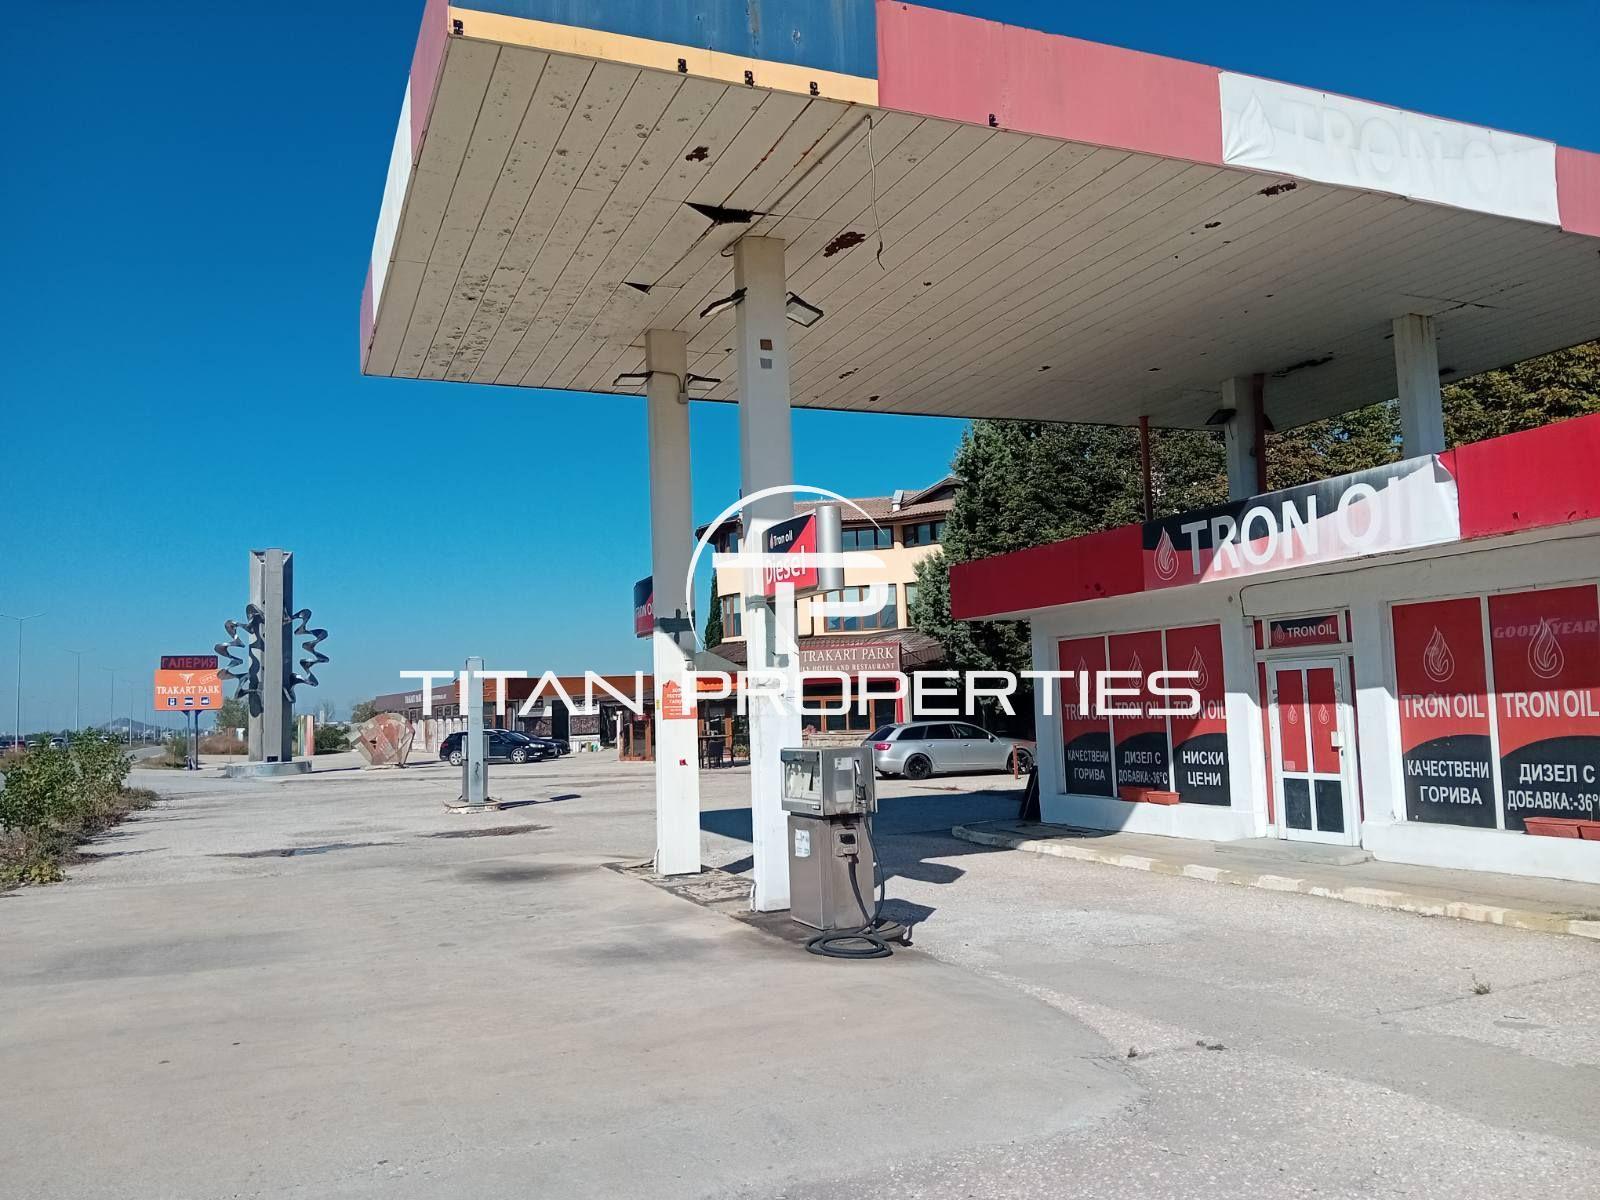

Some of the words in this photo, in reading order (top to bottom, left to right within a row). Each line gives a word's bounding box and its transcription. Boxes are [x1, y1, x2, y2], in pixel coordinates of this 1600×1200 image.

[1181, 495, 1318, 576] TRON
[765, 545, 806, 585] Diesel
[1287, 625, 1316, 638] TRON
[1317, 623, 1337, 636] OIL
[161, 657, 217, 669] ГАЛЕРИЯ
[801, 648, 858, 662] TRAKART
[862, 647, 894, 660] PARK
[156, 686, 196, 695] TRAKART
[197, 685, 220, 694] PARK
[1207, 699, 1227, 720] OIL
[1402, 694, 1452, 718] TRON
[1453, 693, 1485, 718] OIL
[1502, 690, 1560, 718] TRON
[1562, 689, 1600, 718] OIL
[1067, 748, 1109, 764] КАЧЕСТВЕНИ
[1124, 750, 1153, 765] ДИЗЕЛ
[1182, 750, 1225, 766] НИСКИ
[1074, 768, 1106, 782] ГОРИВА
[1407, 760, 1490, 779] КАЧЕСТВЕНИ
[1519, 763, 1578, 785] ДИЗЕЛ
[1187, 771, 1222, 787] ЦЕНИ
[1419, 785, 1483, 805] ГОРИВА
[1507, 789, 1600, 812] ДОБАВКА:-36°
